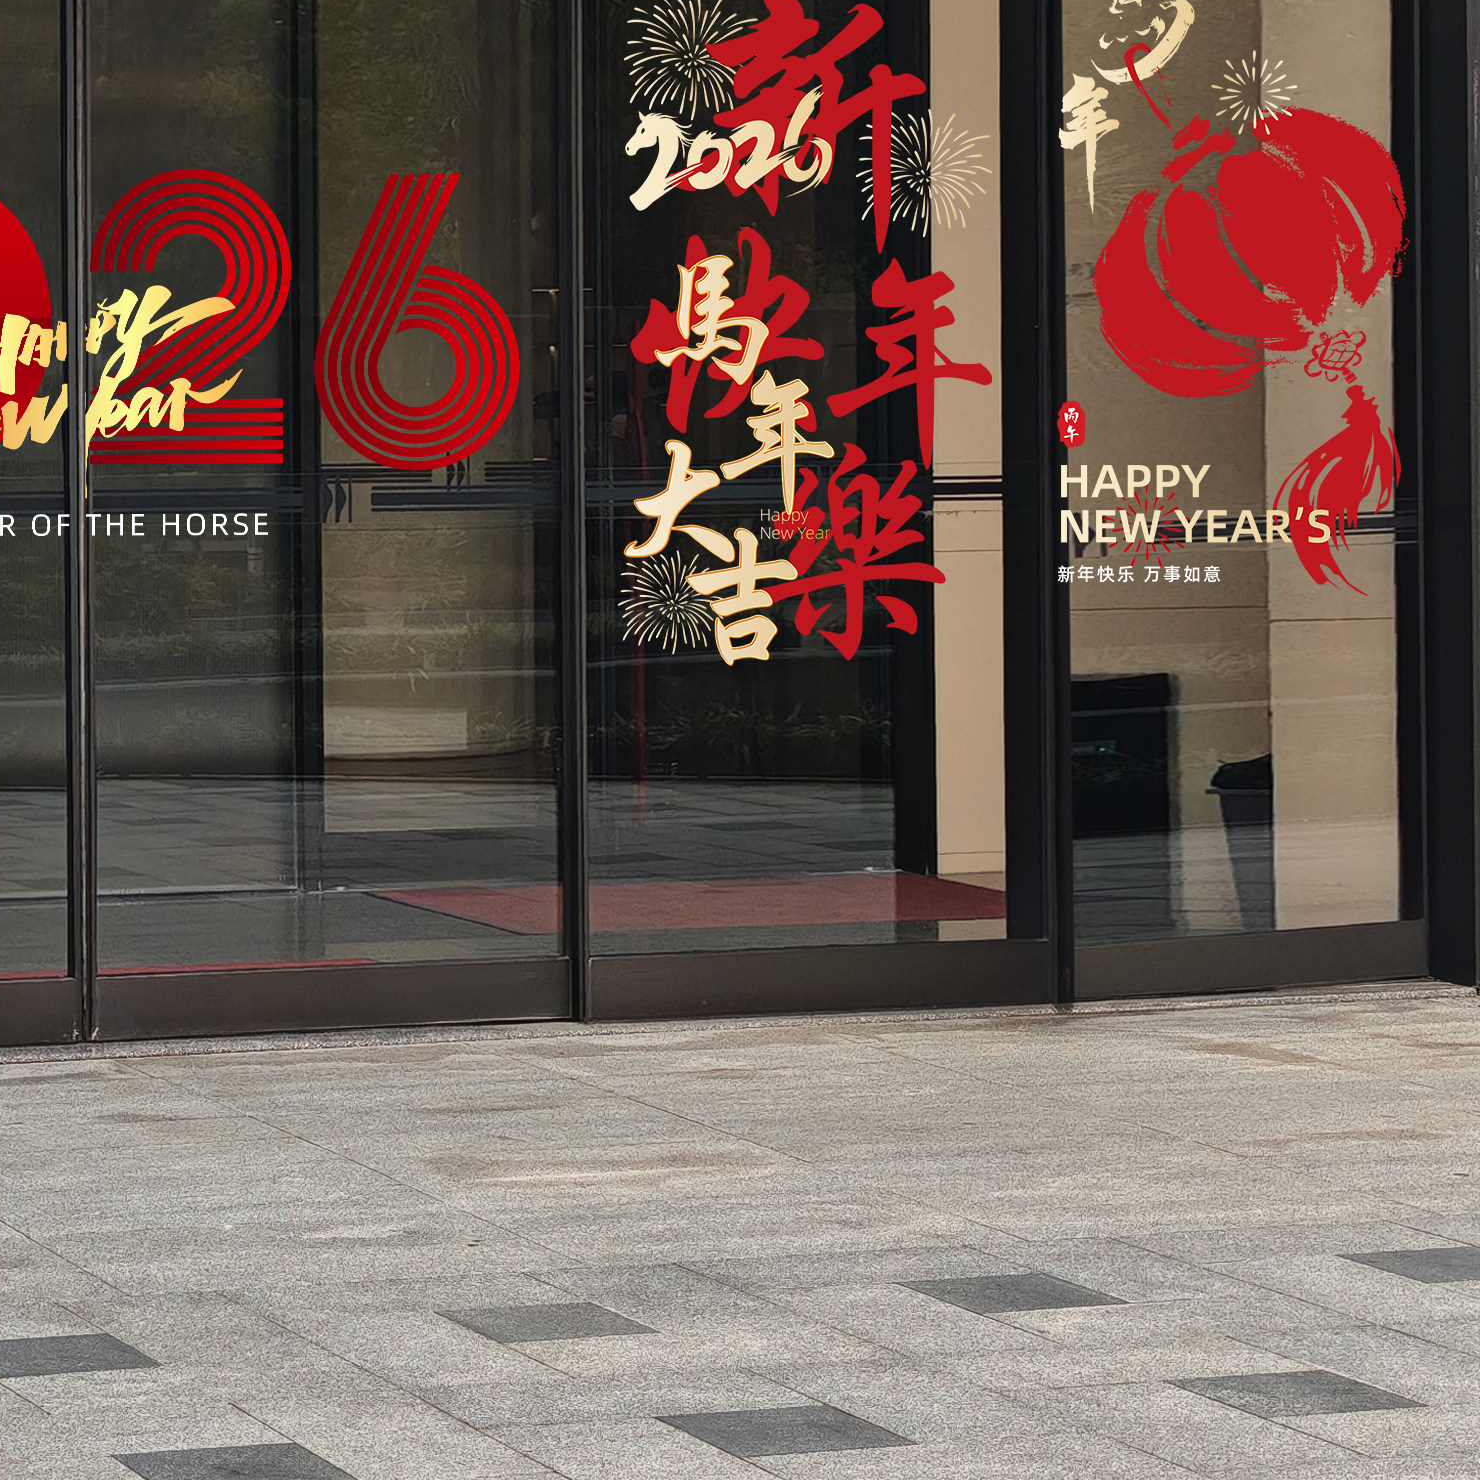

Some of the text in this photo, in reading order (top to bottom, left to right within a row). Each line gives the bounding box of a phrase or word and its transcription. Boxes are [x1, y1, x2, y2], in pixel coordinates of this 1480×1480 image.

[624, 84, 833, 212] 2026
[1060, 464, 1211, 498] HAPPY
[31, 514, 70, 537] OF
[85, 513, 145, 536] THE
[162, 512, 269, 536] HORSE
[760, 508, 809, 525] Happy
[1060, 507, 1331, 543] NEW YEAR'S
[760, 526, 830, 540] New Year
[1057, 565, 1221, 583] 新年快乐 万事如意
